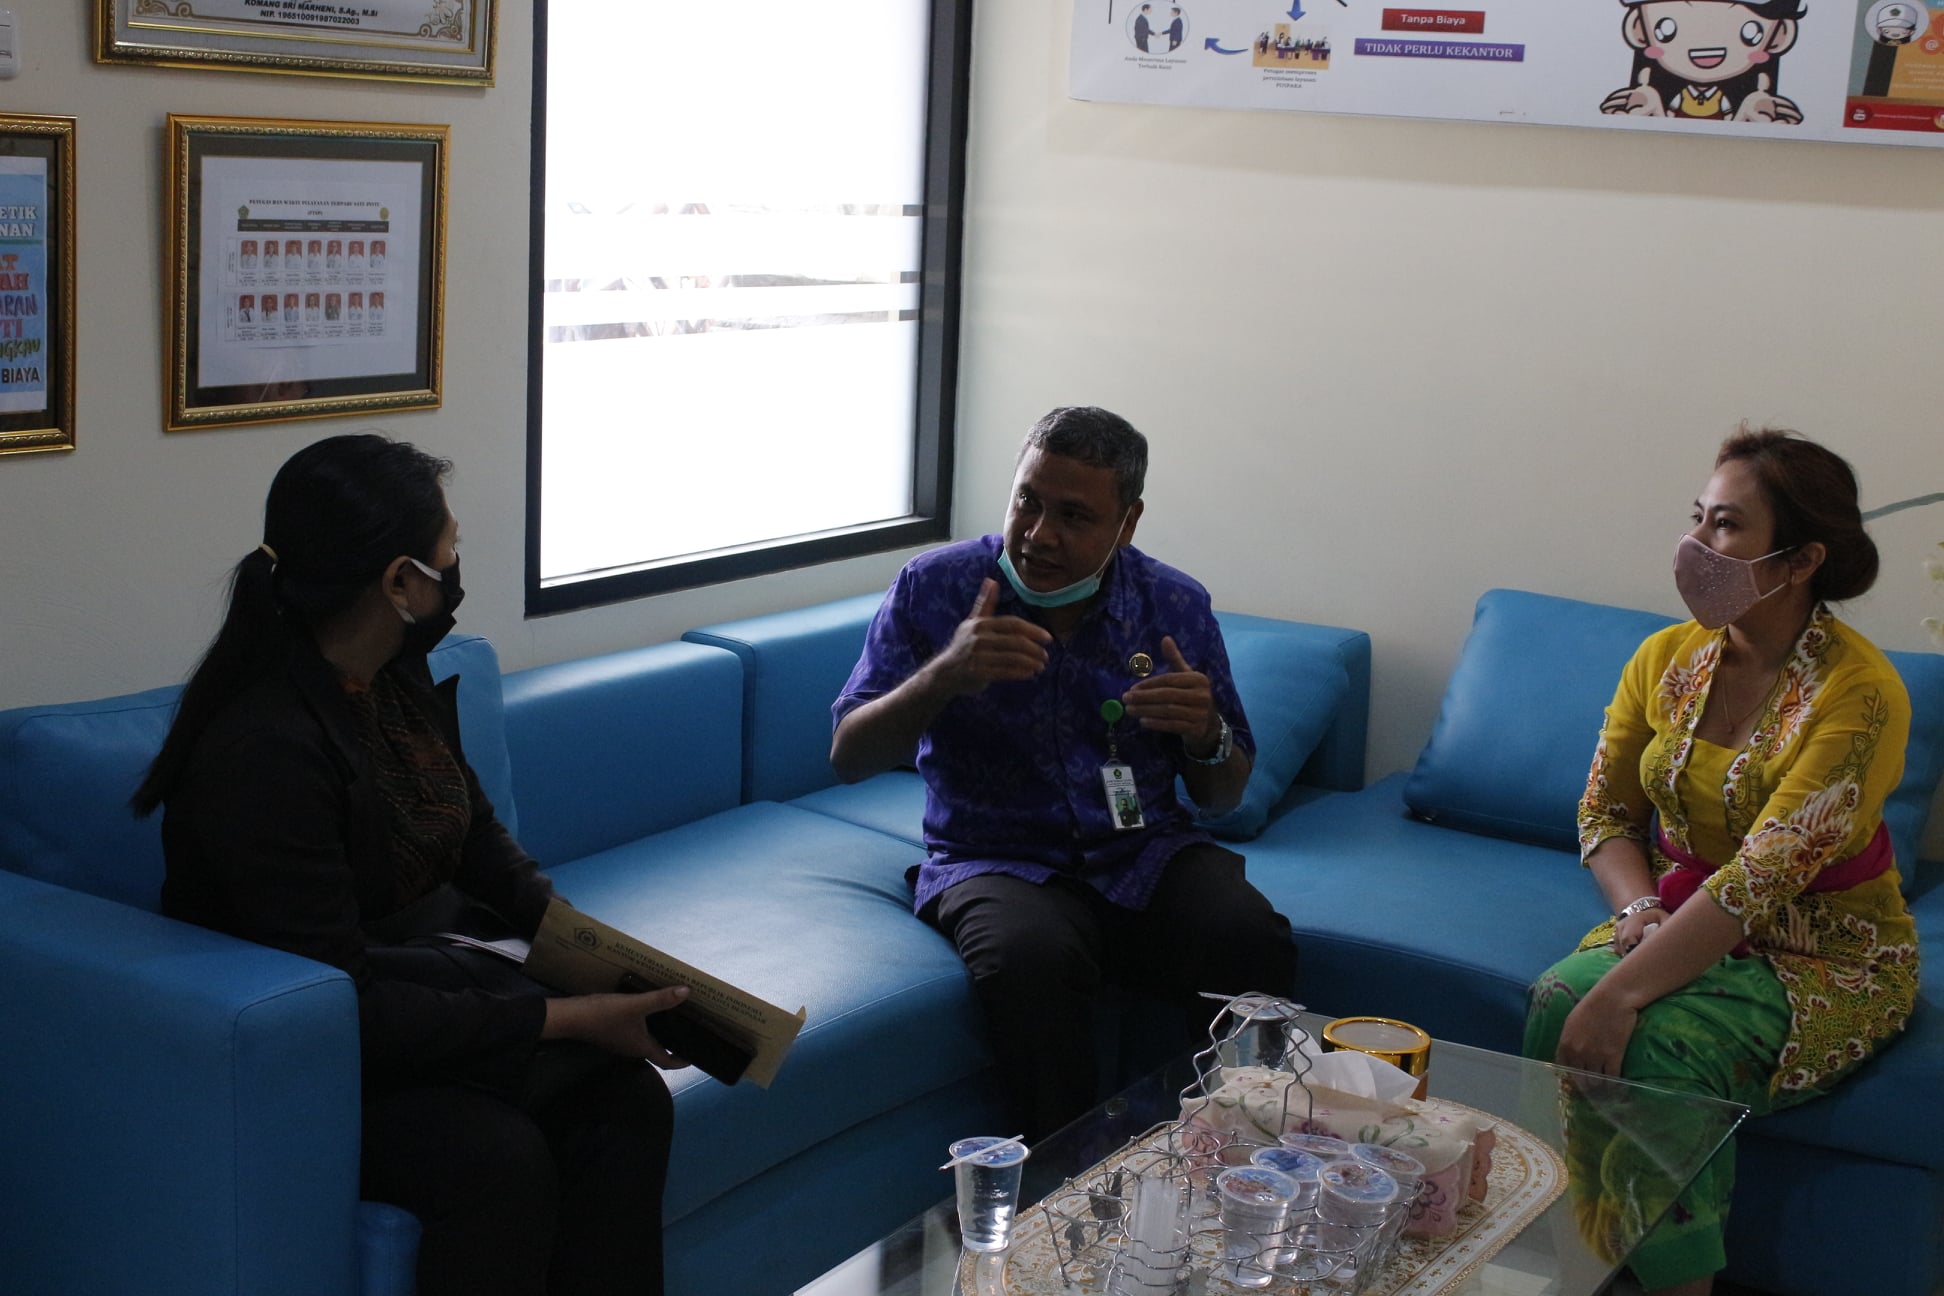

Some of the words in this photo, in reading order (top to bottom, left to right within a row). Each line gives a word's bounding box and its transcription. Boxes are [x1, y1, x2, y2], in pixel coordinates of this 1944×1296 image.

[244, 0, 280, 8] KOMANG
[297, 3, 336, 14] MARHENI,
[1401, 14, 1434, 25] Tanpa
[1437, 16, 1466, 26] Biaya
[1365, 43, 1402, 53] TIDAK
[1404, 45, 1443, 55] PERLU
[1446, 47, 1513, 58] KEKANTOR
[2, 367, 41, 383] BIAYA
